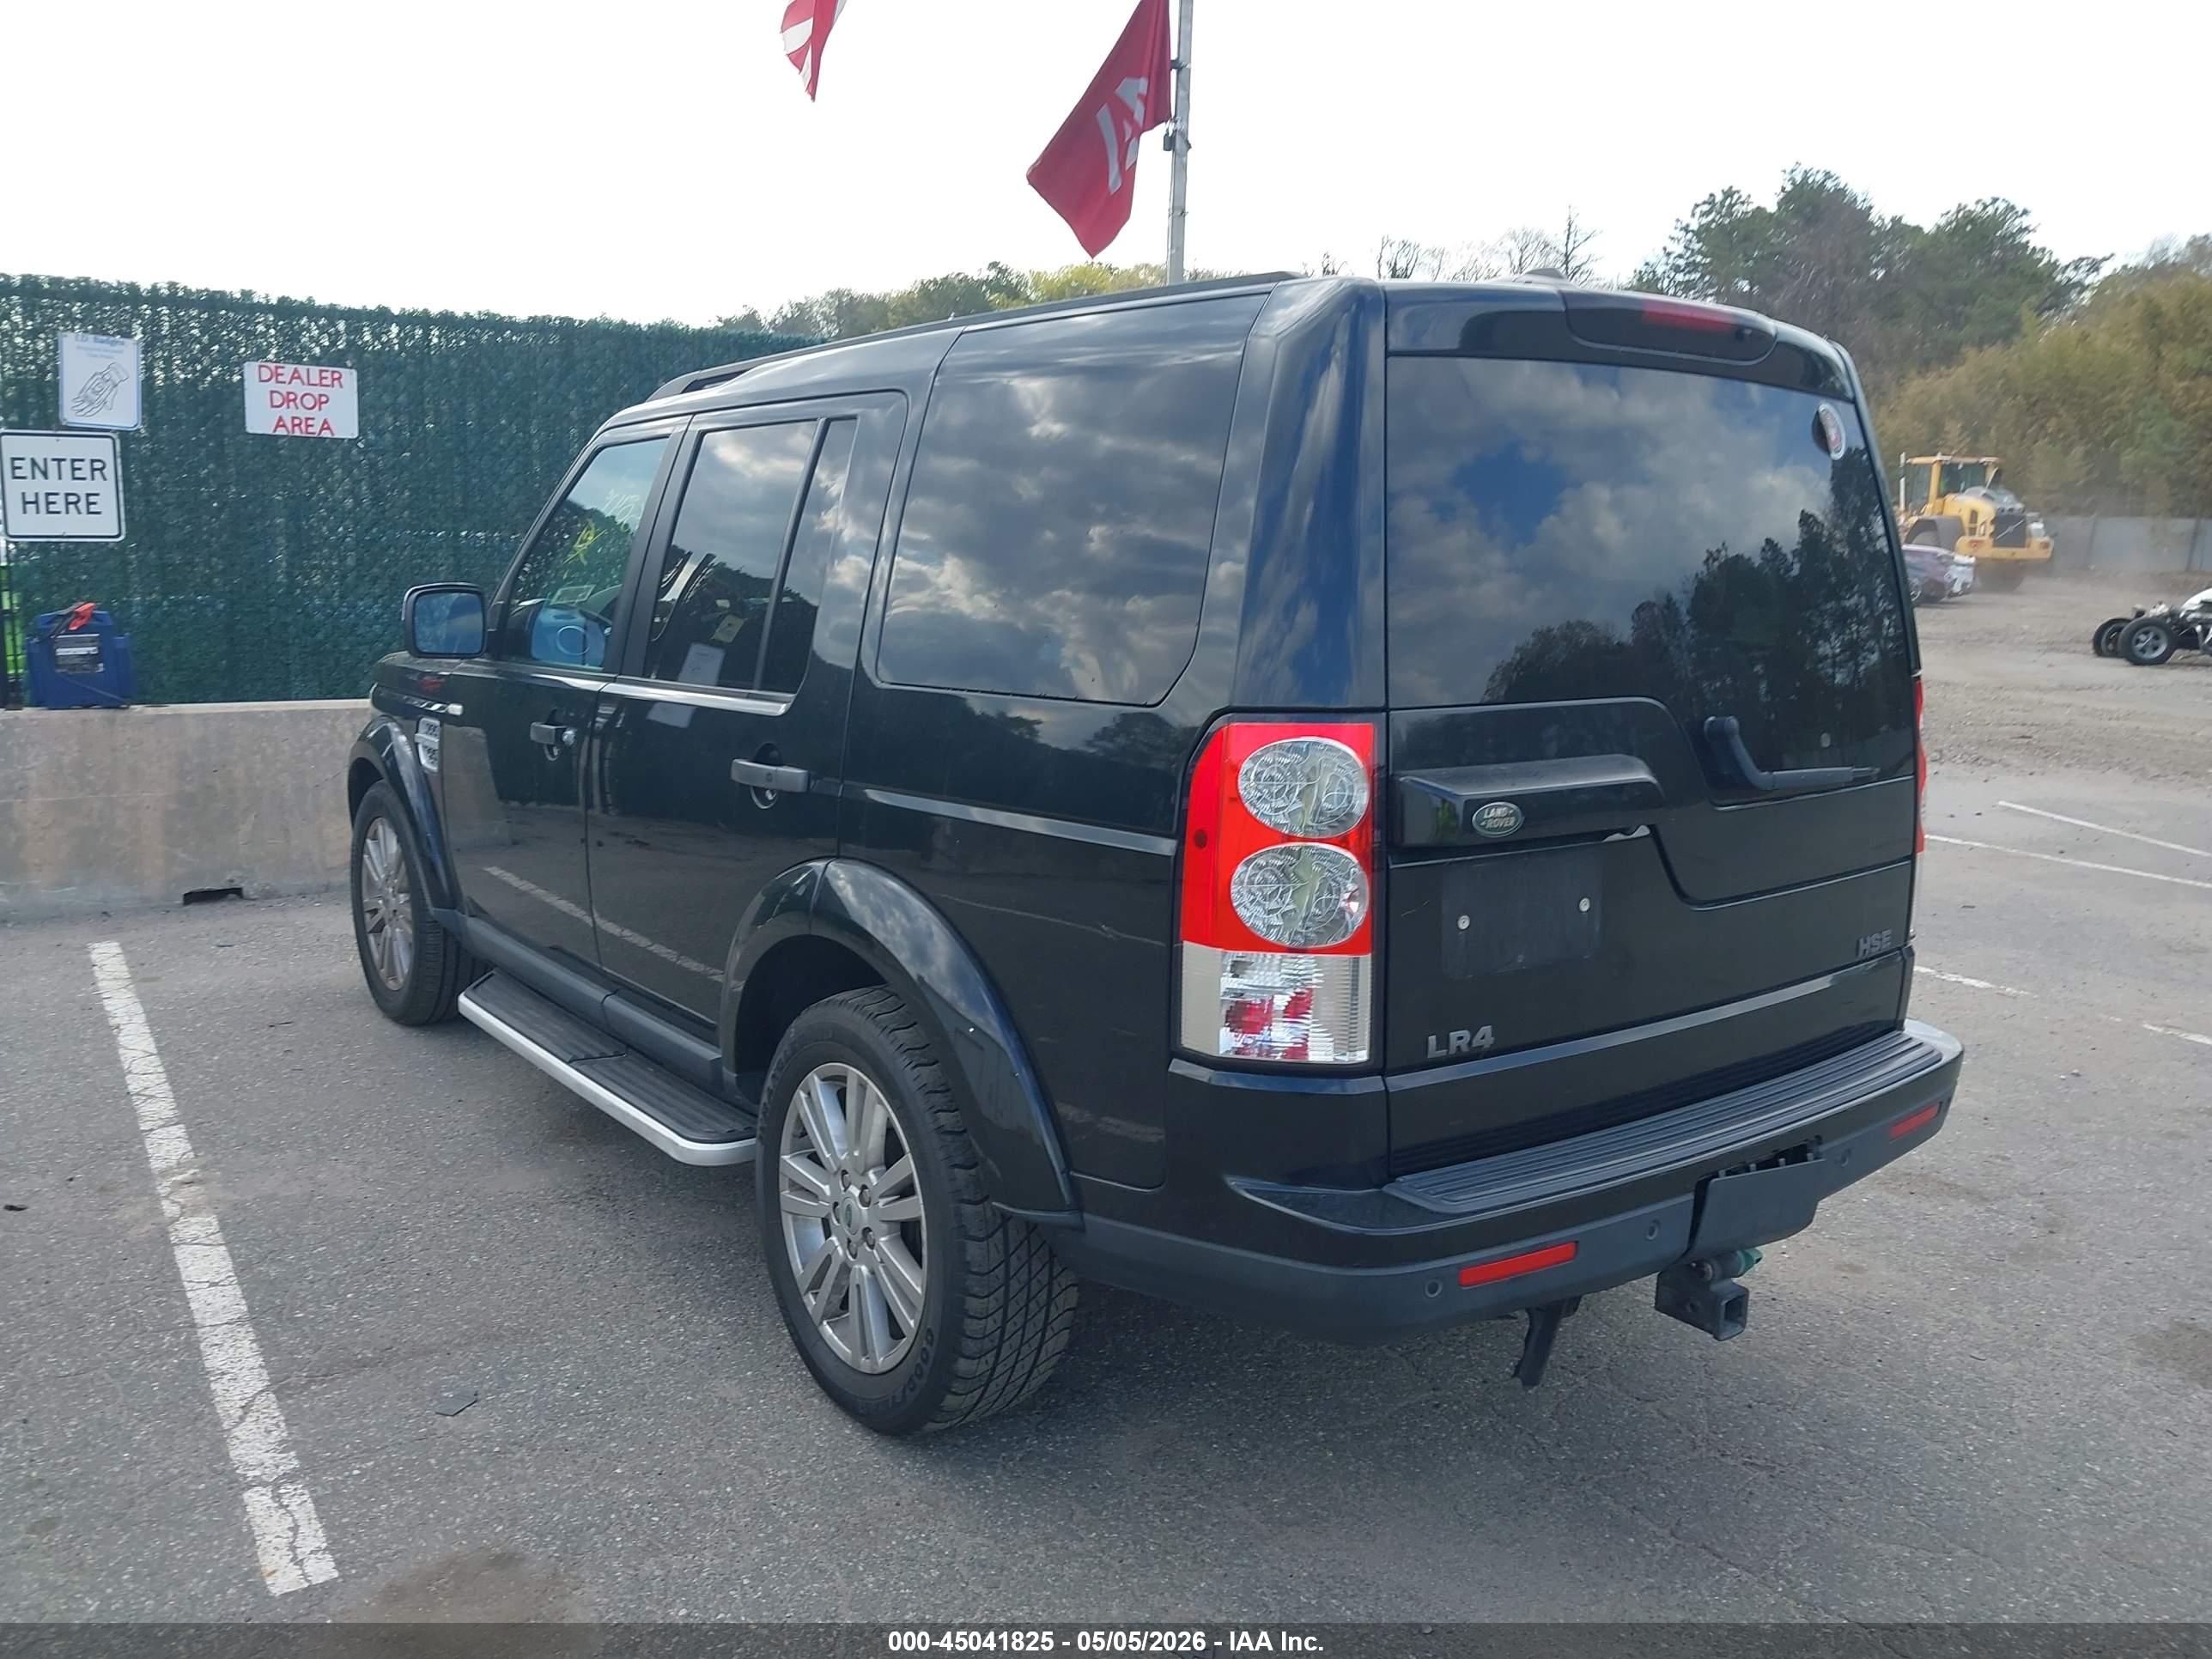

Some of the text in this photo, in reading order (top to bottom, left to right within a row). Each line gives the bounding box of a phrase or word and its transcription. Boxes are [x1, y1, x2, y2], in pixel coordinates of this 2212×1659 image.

[258, 364, 343, 388] DEALER
[269, 389, 330, 411] DROP
[272, 415, 335, 436] AREA
[9, 456, 107, 481] ENTER
[21, 491, 103, 515] HERE
[1483, 806, 1508, 819] LAND
[1485, 817, 1516, 830] ROVER
[1857, 928, 1892, 957] HSE
[1427, 1024, 1495, 1059] LR4
